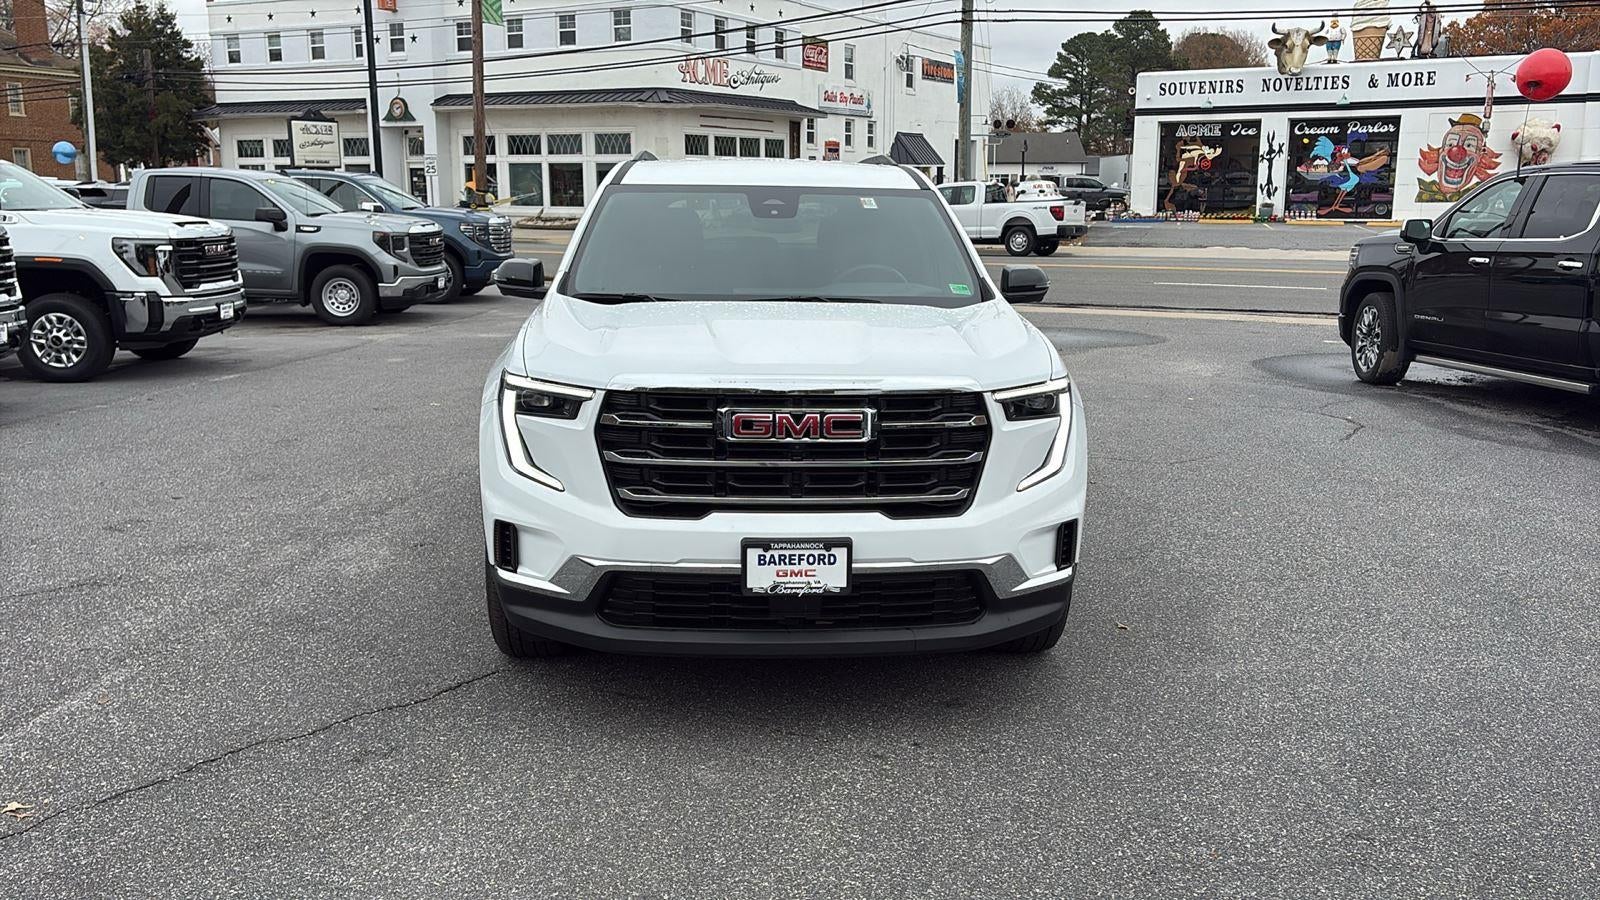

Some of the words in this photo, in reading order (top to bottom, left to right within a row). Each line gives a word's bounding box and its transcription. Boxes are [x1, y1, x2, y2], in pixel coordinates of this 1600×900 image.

[678, 55, 729, 87] ACME
[1159, 79, 1244, 96] SOUVENIRS
[1261, 75, 1350, 93] NOVELTIES
[1368, 73, 1379, 89] &
[1387, 71, 1437, 88] MORE
[1176, 124, 1222, 137] ACME
[1230, 122, 1258, 136] Ice
[1294, 121, 1341, 135] Cream
[1347, 120, 1397, 134] Parlor
[425, 165, 437, 174] 25
[1414, 314, 1444, 322] DENALI
[732, 413, 864, 438] GMC
[770, 542, 825, 550] TAPPAHANNOCK
[757, 553, 837, 566] BAREFORD
[776, 569, 817, 578] GMC
[767, 583, 829, 597] Bareford
